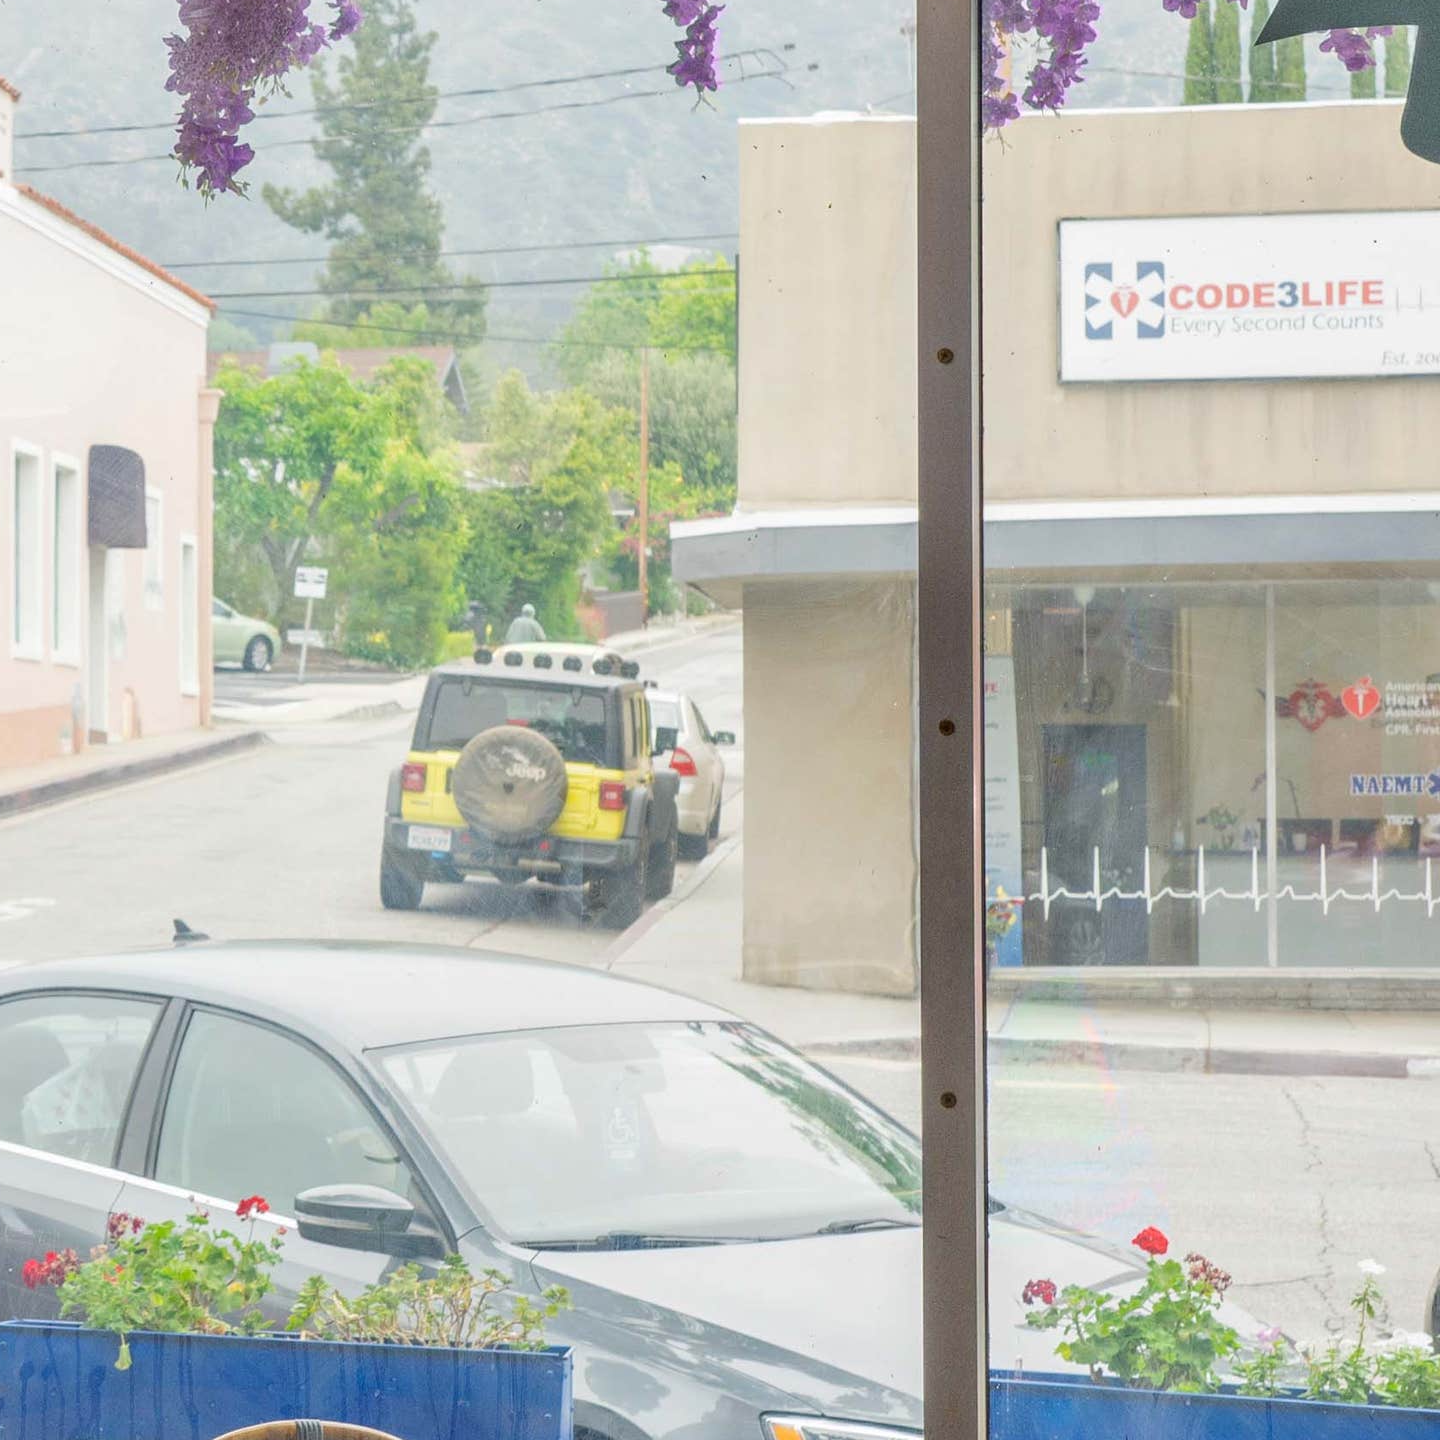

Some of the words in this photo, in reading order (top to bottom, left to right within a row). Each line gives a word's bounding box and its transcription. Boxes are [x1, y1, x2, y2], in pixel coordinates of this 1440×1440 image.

[1168, 280, 1384, 310] CODE3LIFE
[1170, 315, 1226, 337] Every
[1232, 313, 1305, 333] Second
[1312, 312, 1384, 330] Counts
[1385, 693, 1429, 706] Heart
[505, 765, 546, 782] Jeep
[1351, 775, 1425, 794] NAEMT
